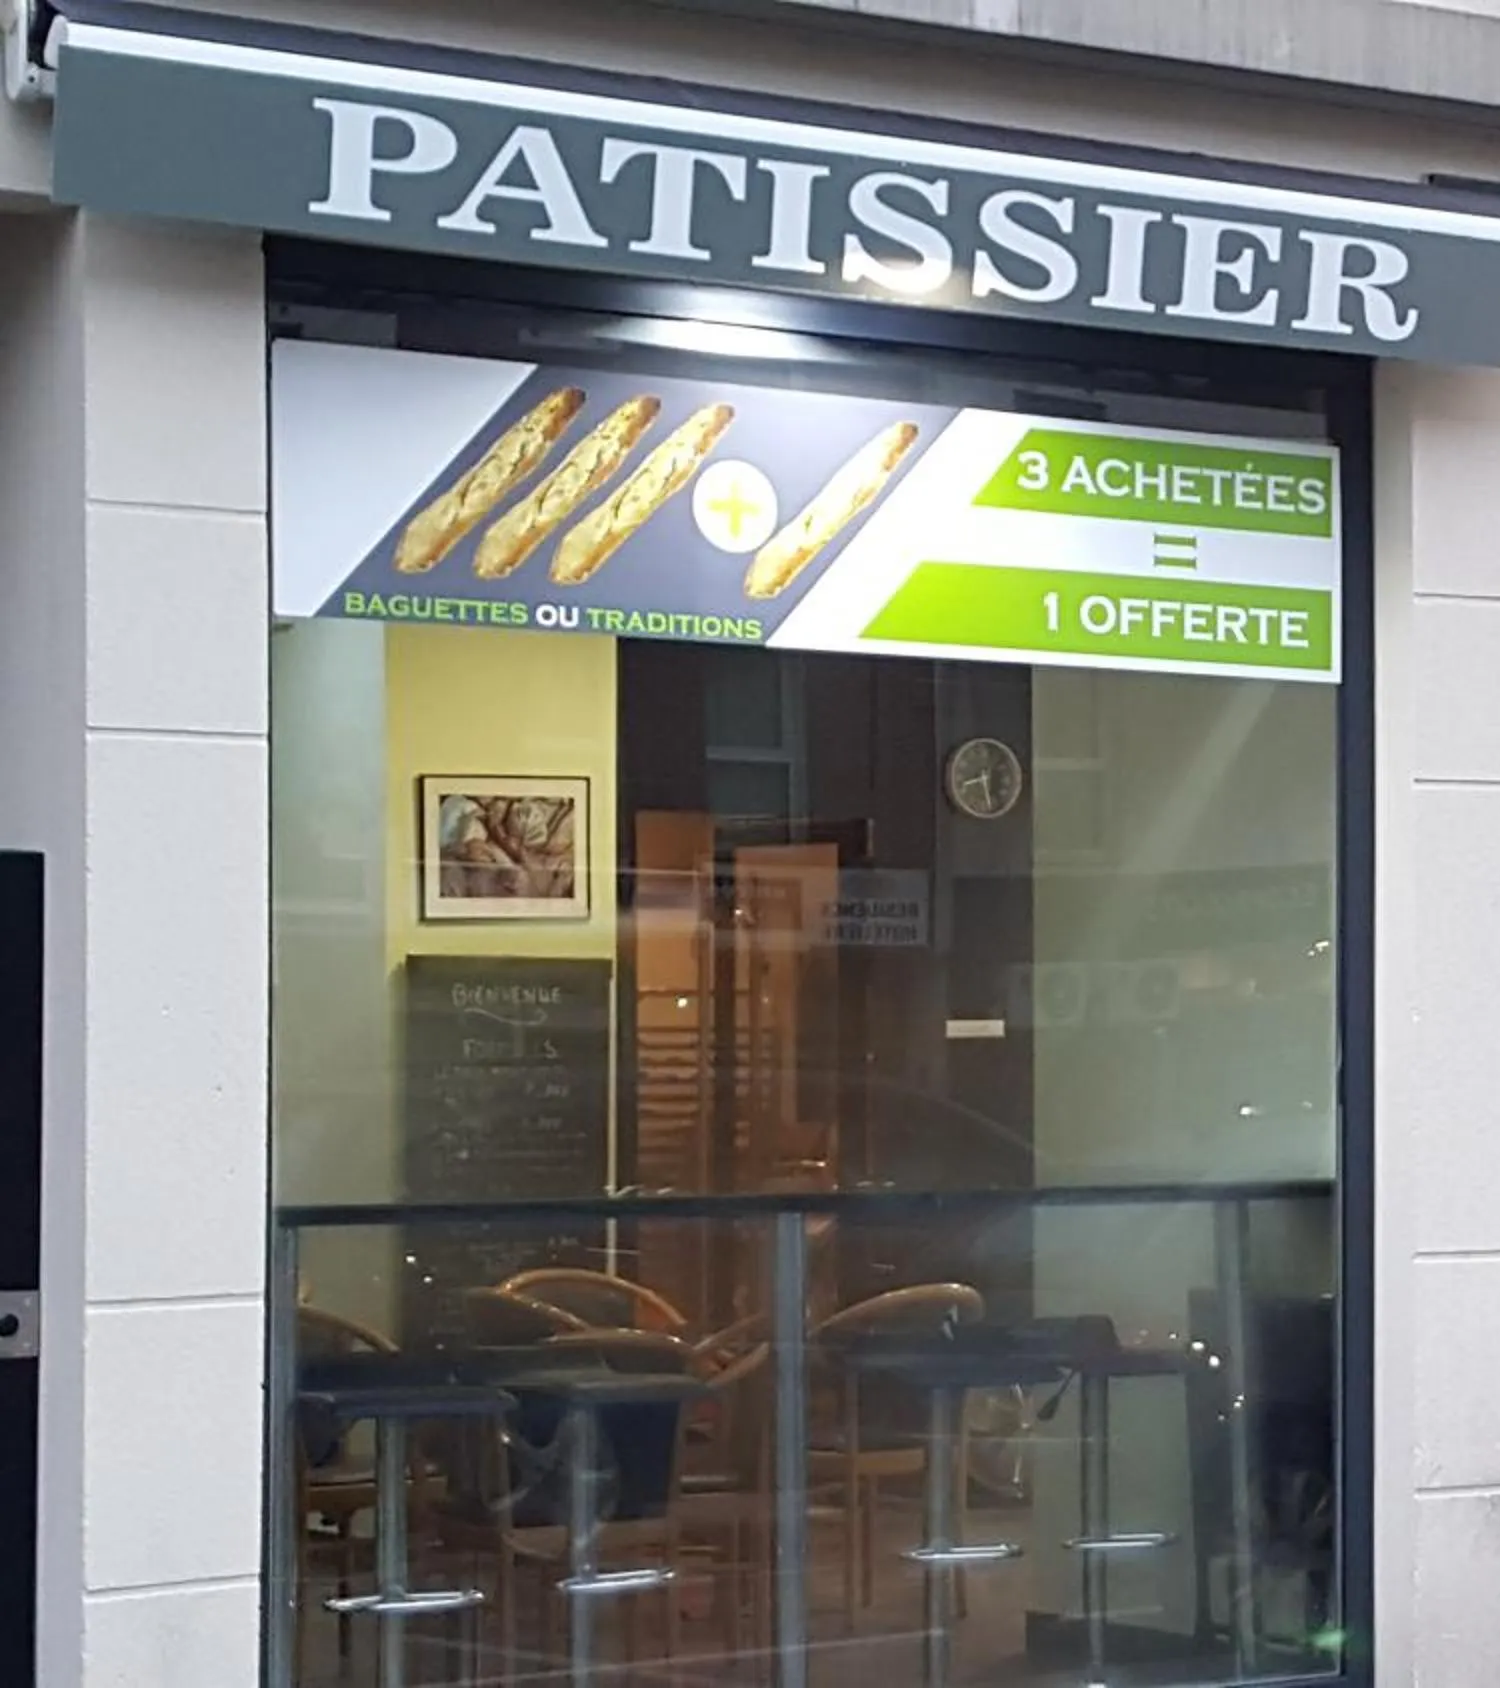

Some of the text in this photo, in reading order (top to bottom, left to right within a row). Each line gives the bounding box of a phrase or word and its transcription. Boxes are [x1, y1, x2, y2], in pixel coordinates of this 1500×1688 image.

[308, 97, 1420, 343] PATISSIER
[1016, 450, 1328, 514] 3 ACHETÉES
[344, 592, 763, 641] BAGUETTES OU TRADITIONS
[1042, 591, 1309, 649] 1 OFFERTE
